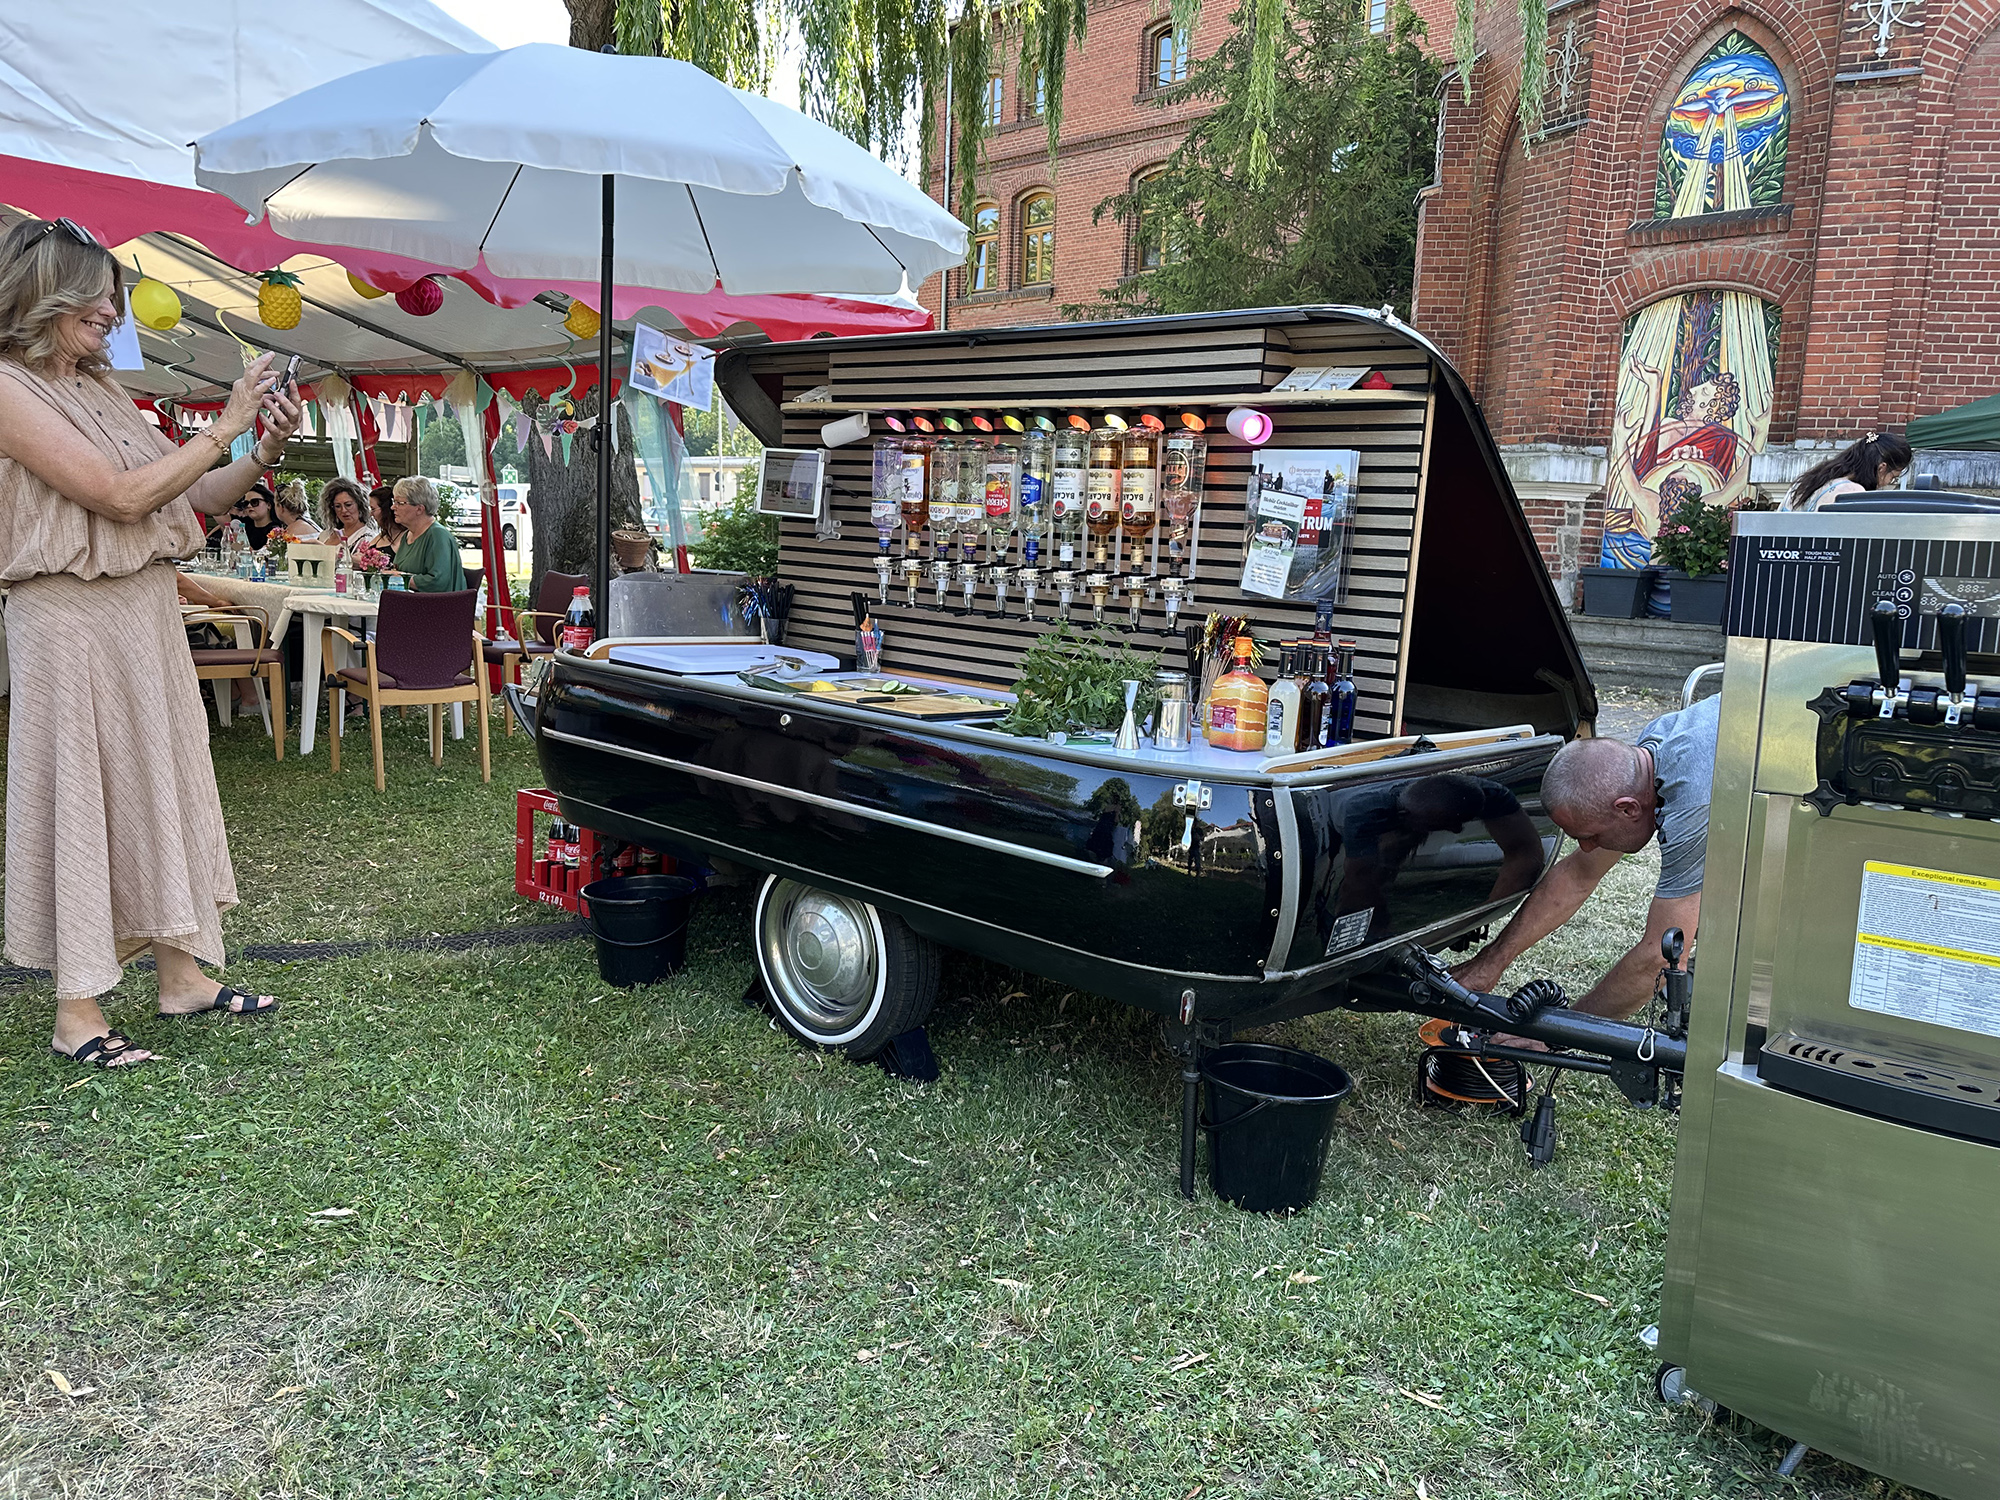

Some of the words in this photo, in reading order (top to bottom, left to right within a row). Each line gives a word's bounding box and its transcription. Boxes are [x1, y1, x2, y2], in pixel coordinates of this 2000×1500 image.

[1301, 516, 1333, 531] TRUM
[1759, 550, 1800, 560] VEVOR
[1911, 869, 1955, 882] Exceptional
[1955, 877, 1987, 887] remarks
[539, 891, 546, 899] 12
[551, 895, 560, 905] 1.0
[1862, 935, 1881, 944] Simple
[1881, 938, 1914, 950] explanation
[1913, 944, 1928, 952] table
[1945, 949, 1973, 960] exclusion
